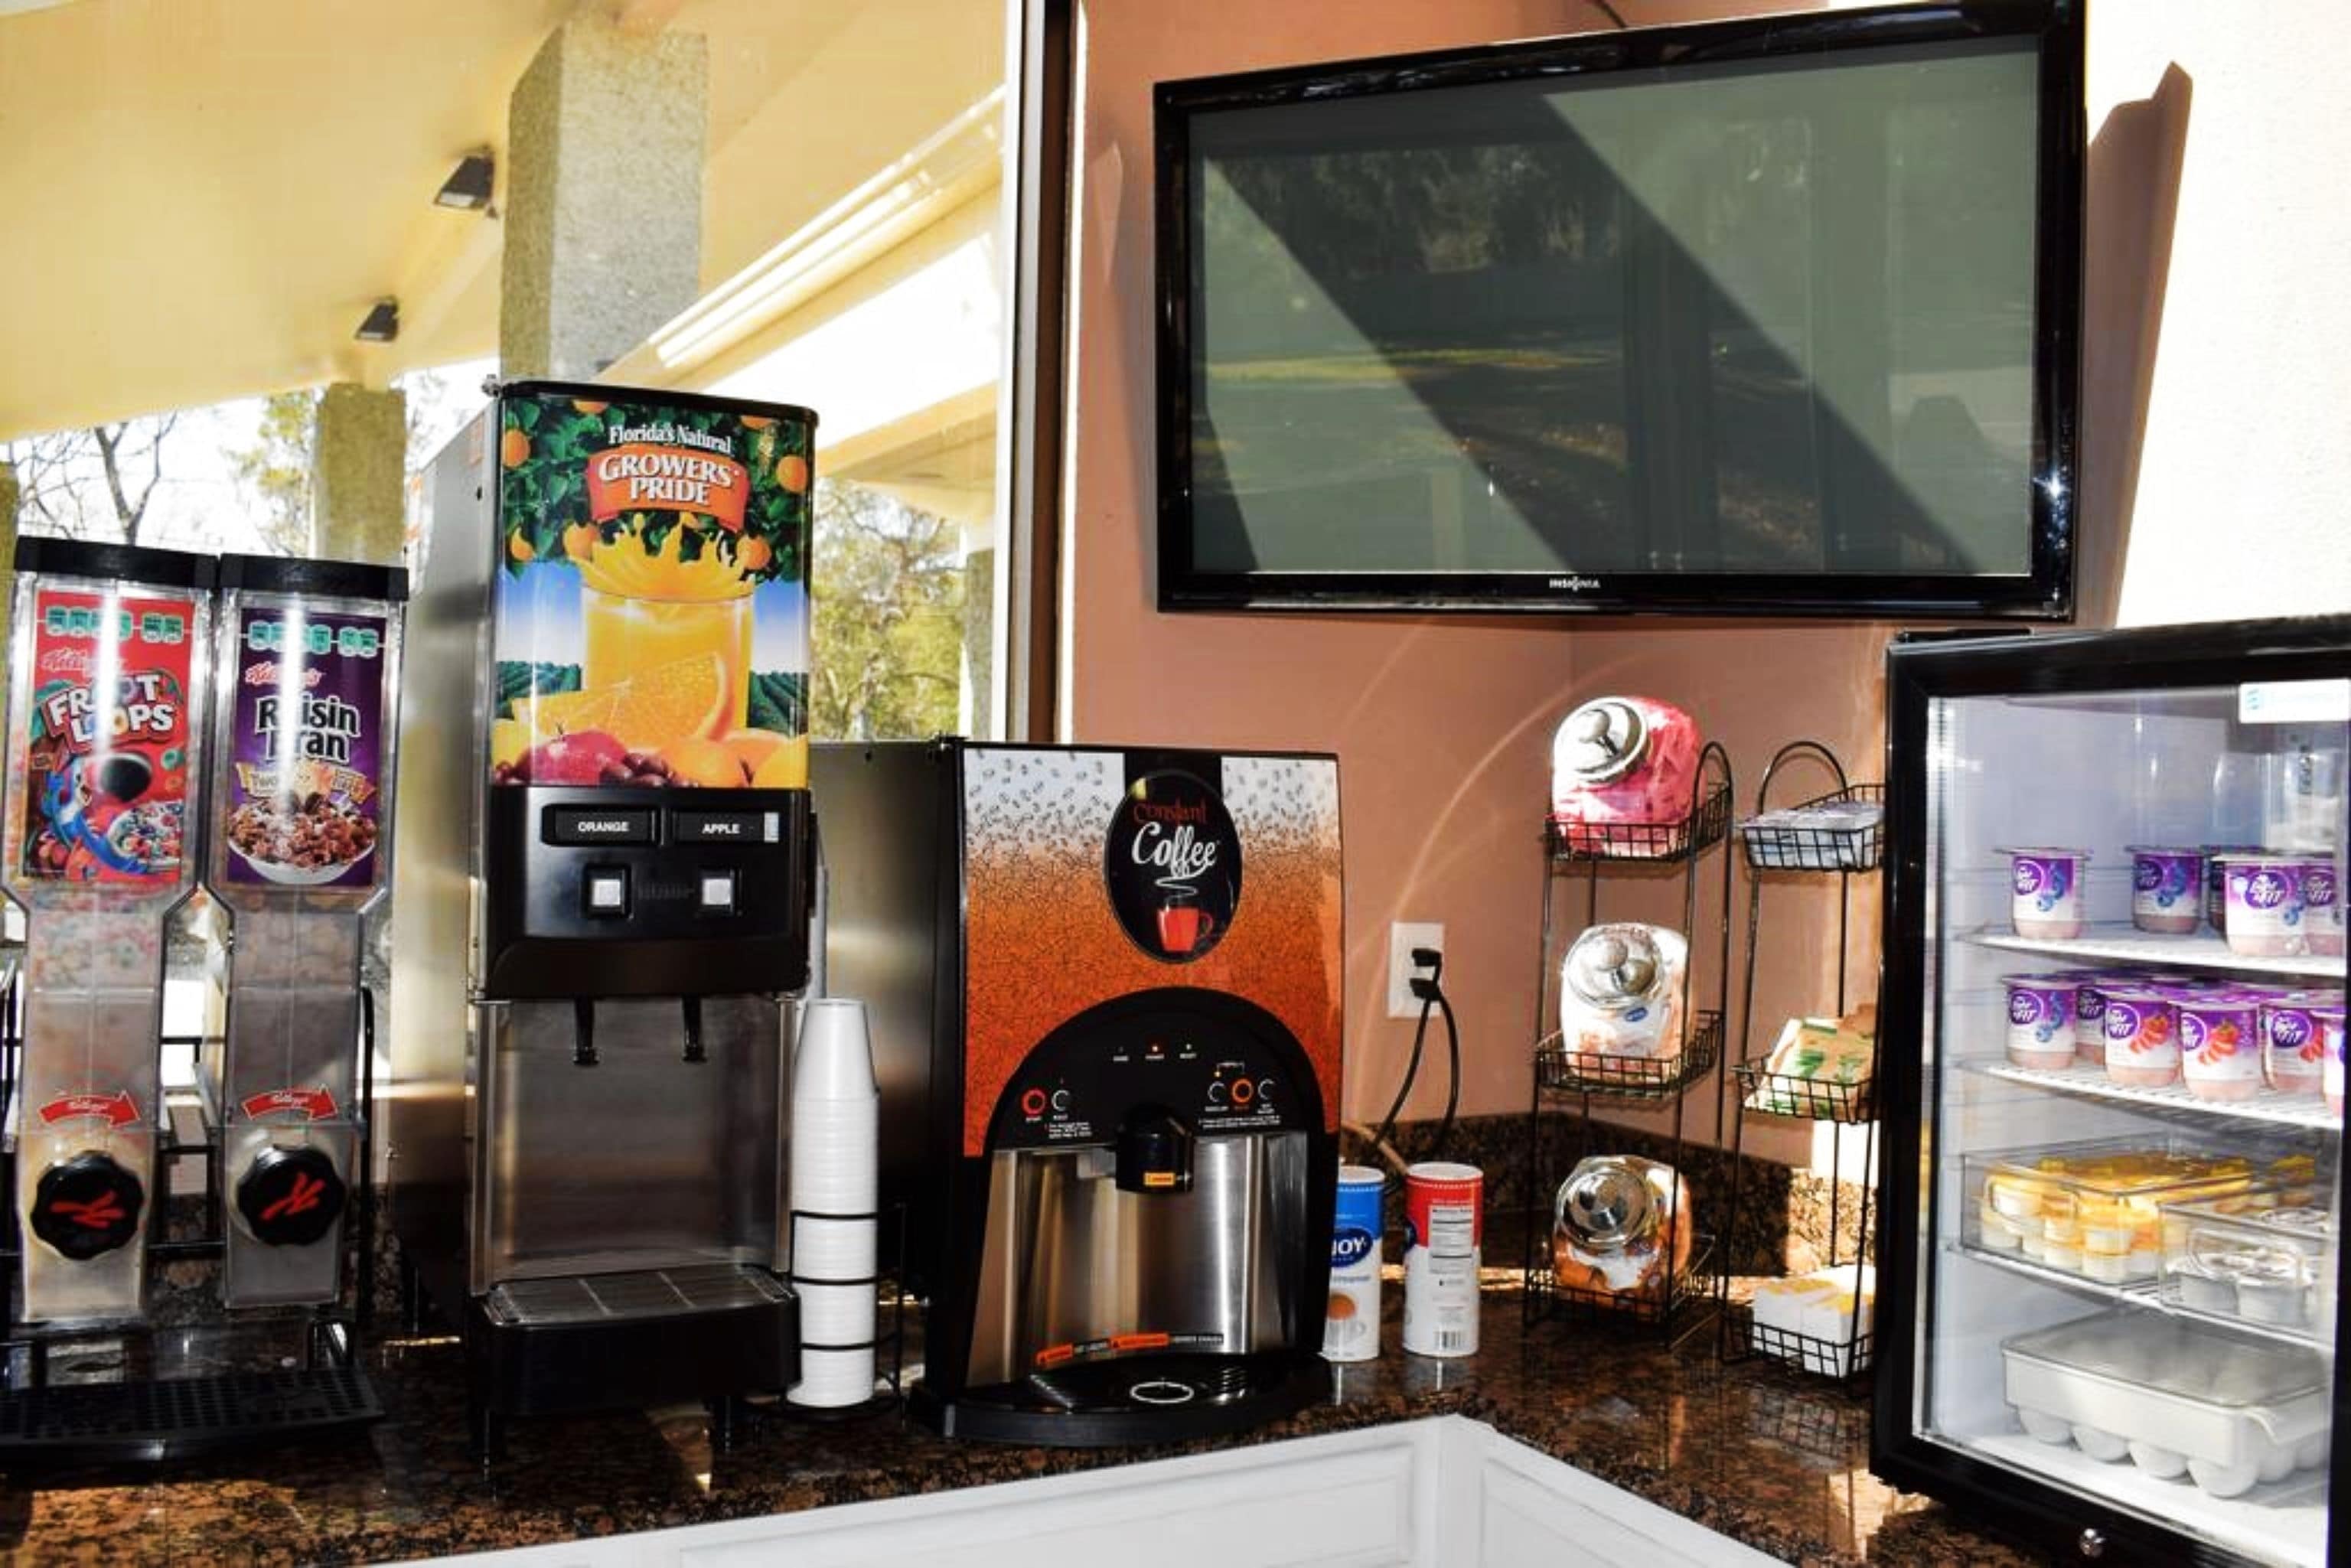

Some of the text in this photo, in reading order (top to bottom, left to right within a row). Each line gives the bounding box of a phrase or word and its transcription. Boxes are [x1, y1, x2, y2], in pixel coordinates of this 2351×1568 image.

[608, 422, 732, 454] Florida's Natural
[631, 477, 711, 506] PRIDE
[47, 673, 160, 727] FROT
[257, 693, 358, 735] Risin
[267, 729, 349, 763] ran
[577, 820, 630, 832] ORANGE
[702, 823, 740, 834] APPLE
[1131, 821, 1217, 879] Coffee
